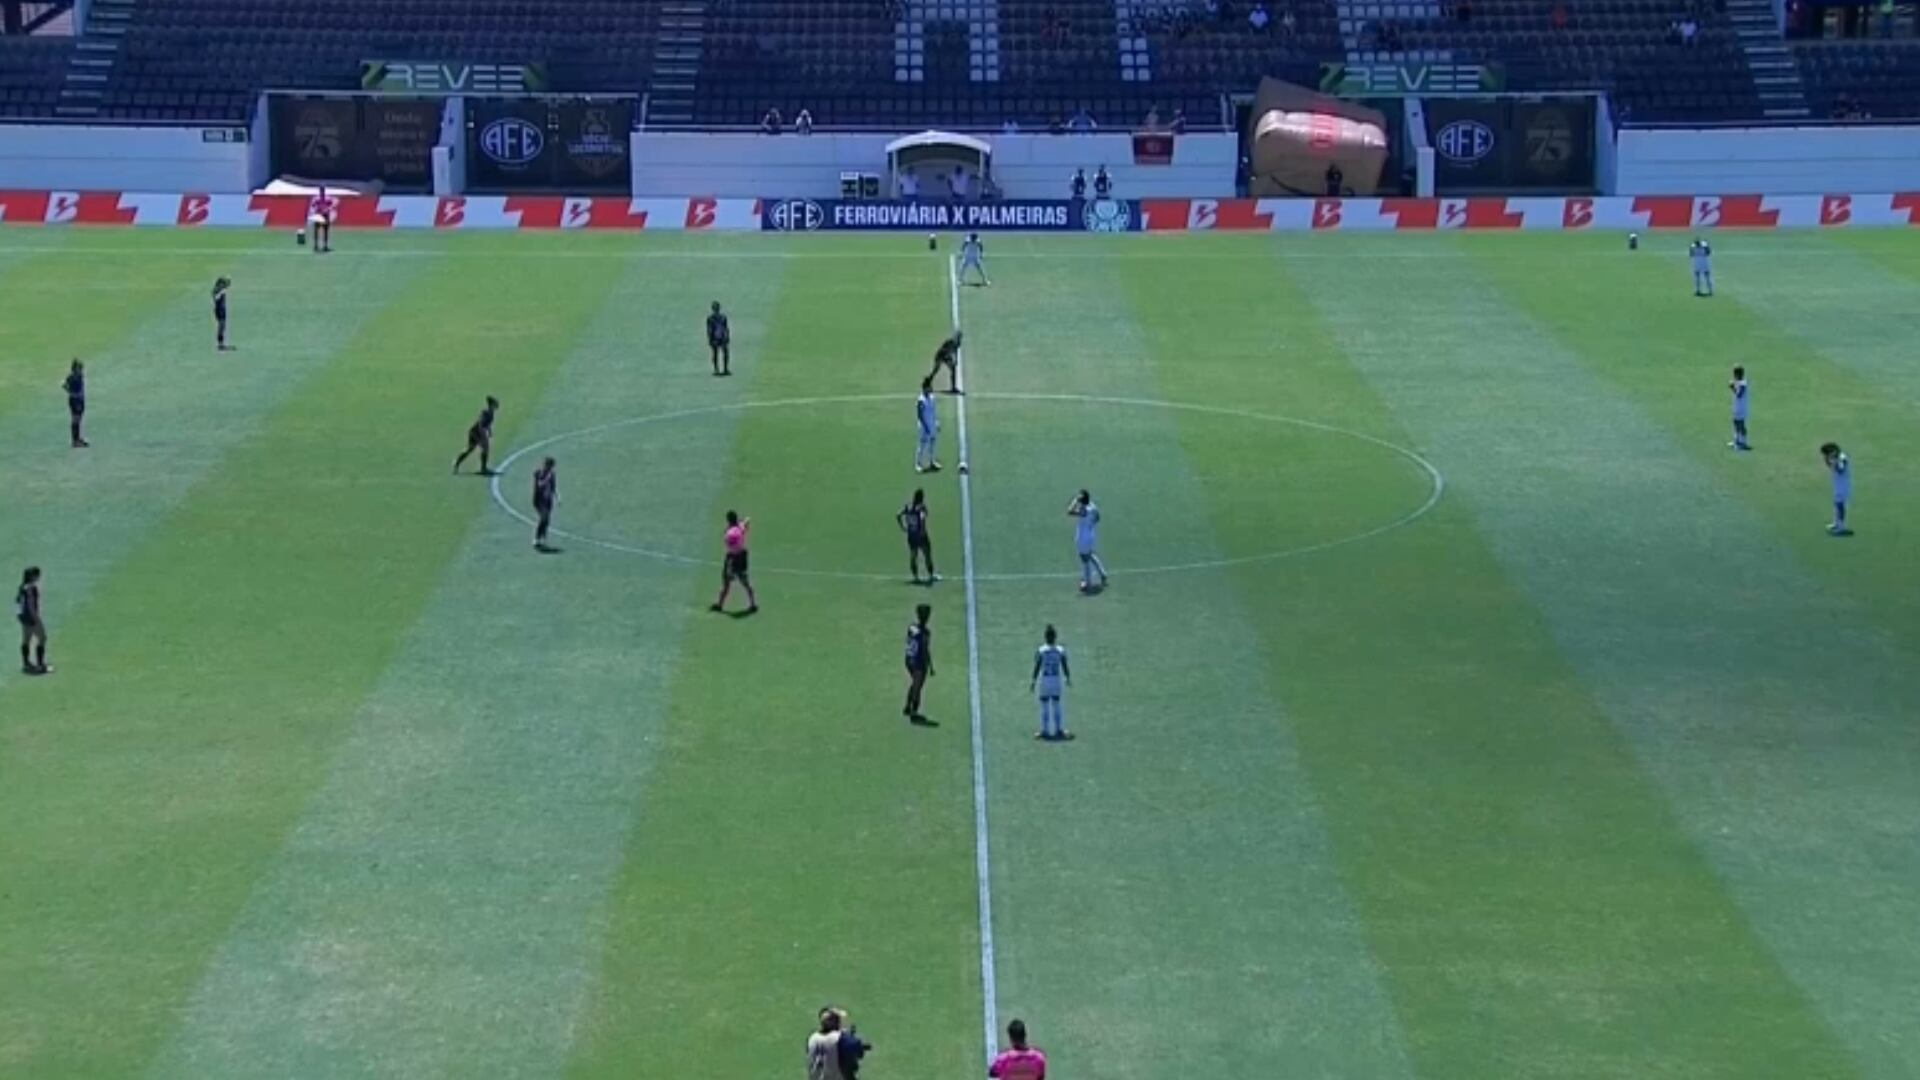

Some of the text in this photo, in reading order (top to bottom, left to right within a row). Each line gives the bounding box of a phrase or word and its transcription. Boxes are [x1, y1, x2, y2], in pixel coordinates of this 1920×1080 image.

[385, 64, 524, 89] REVEE
[1343, 65, 1480, 91] REVEE
[294, 126, 343, 159] 75
[1526, 128, 1572, 161] 75
[774, 200, 820, 230] AFE
[834, 201, 1068, 226] FERROVIÁRIA X PALMEIRAS
